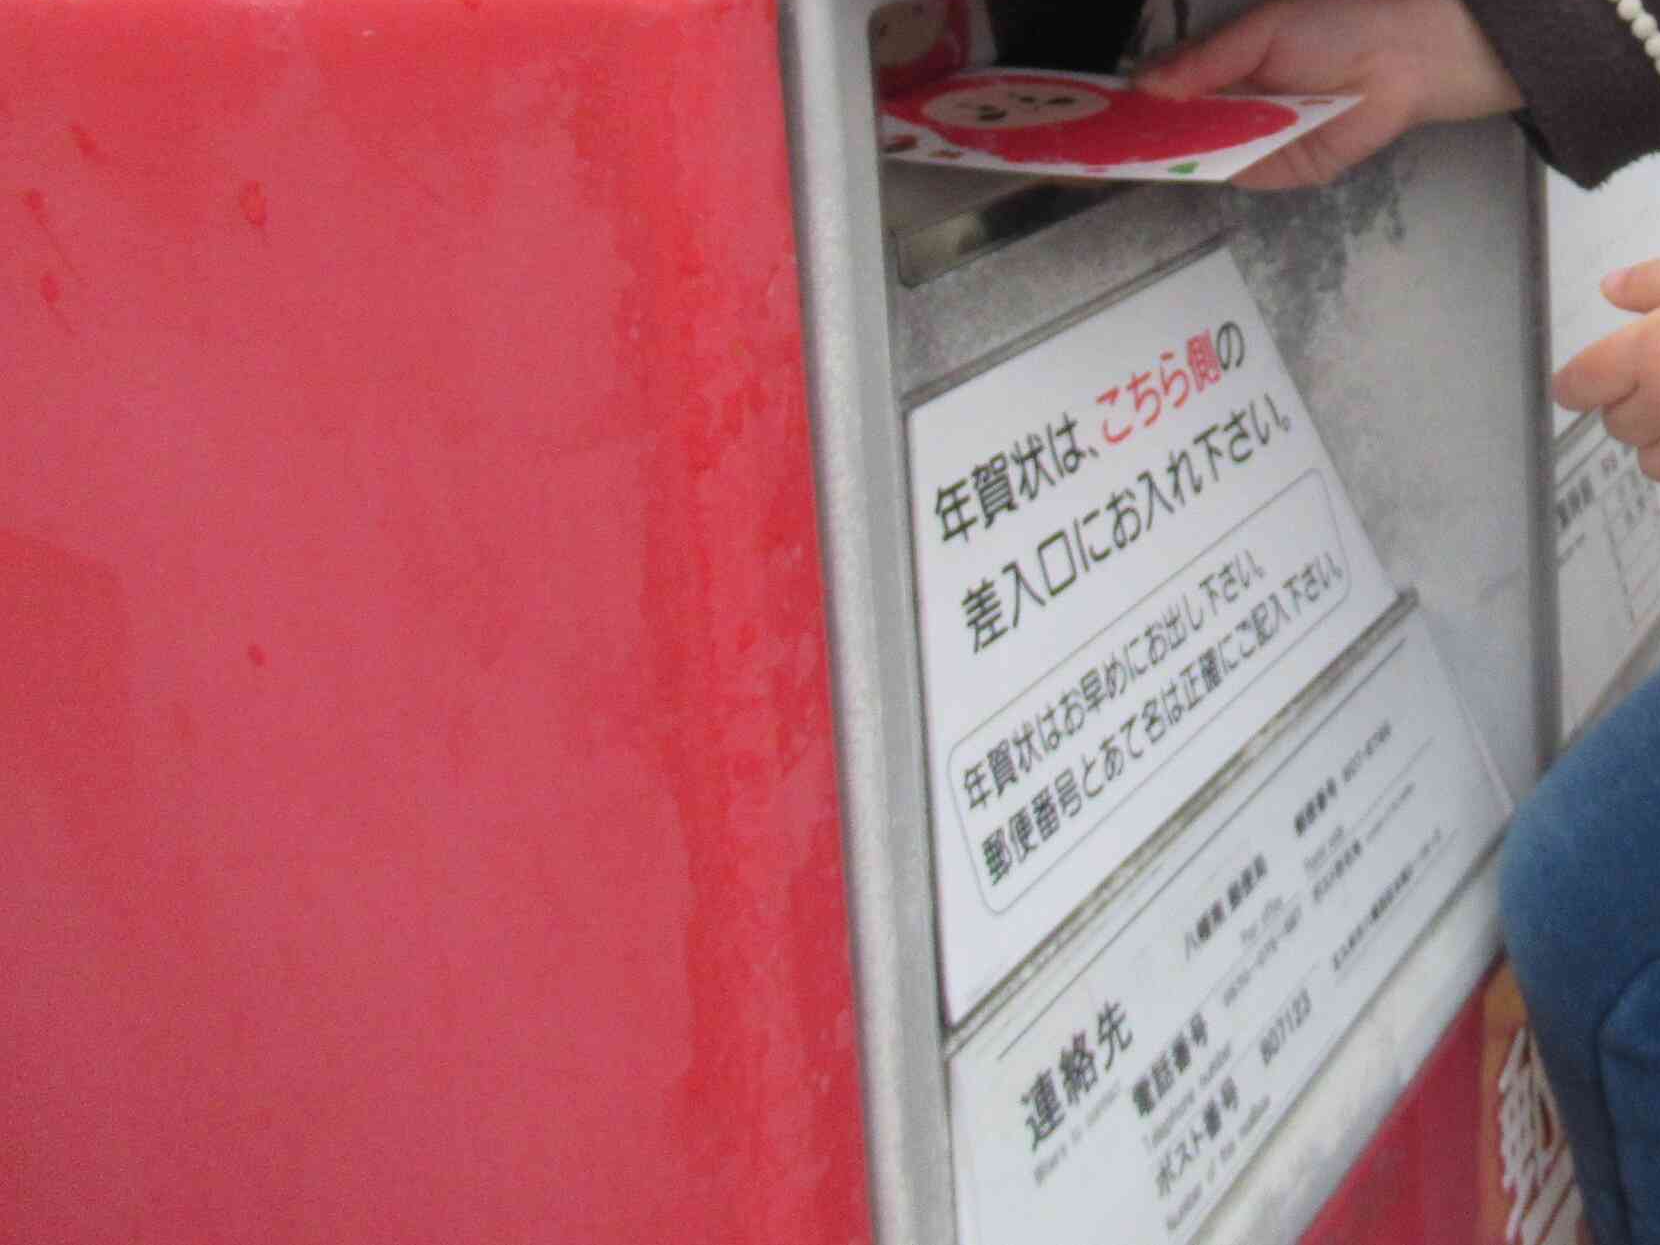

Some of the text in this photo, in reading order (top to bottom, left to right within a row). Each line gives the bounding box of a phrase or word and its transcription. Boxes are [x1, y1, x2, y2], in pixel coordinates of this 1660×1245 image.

[935, 320, 1245, 543] 年賀状は、こちら側の
[961, 393, 1292, 654] 差入口にお入れ下さい。
[1020, 1001, 1133, 1152] 連絡先
